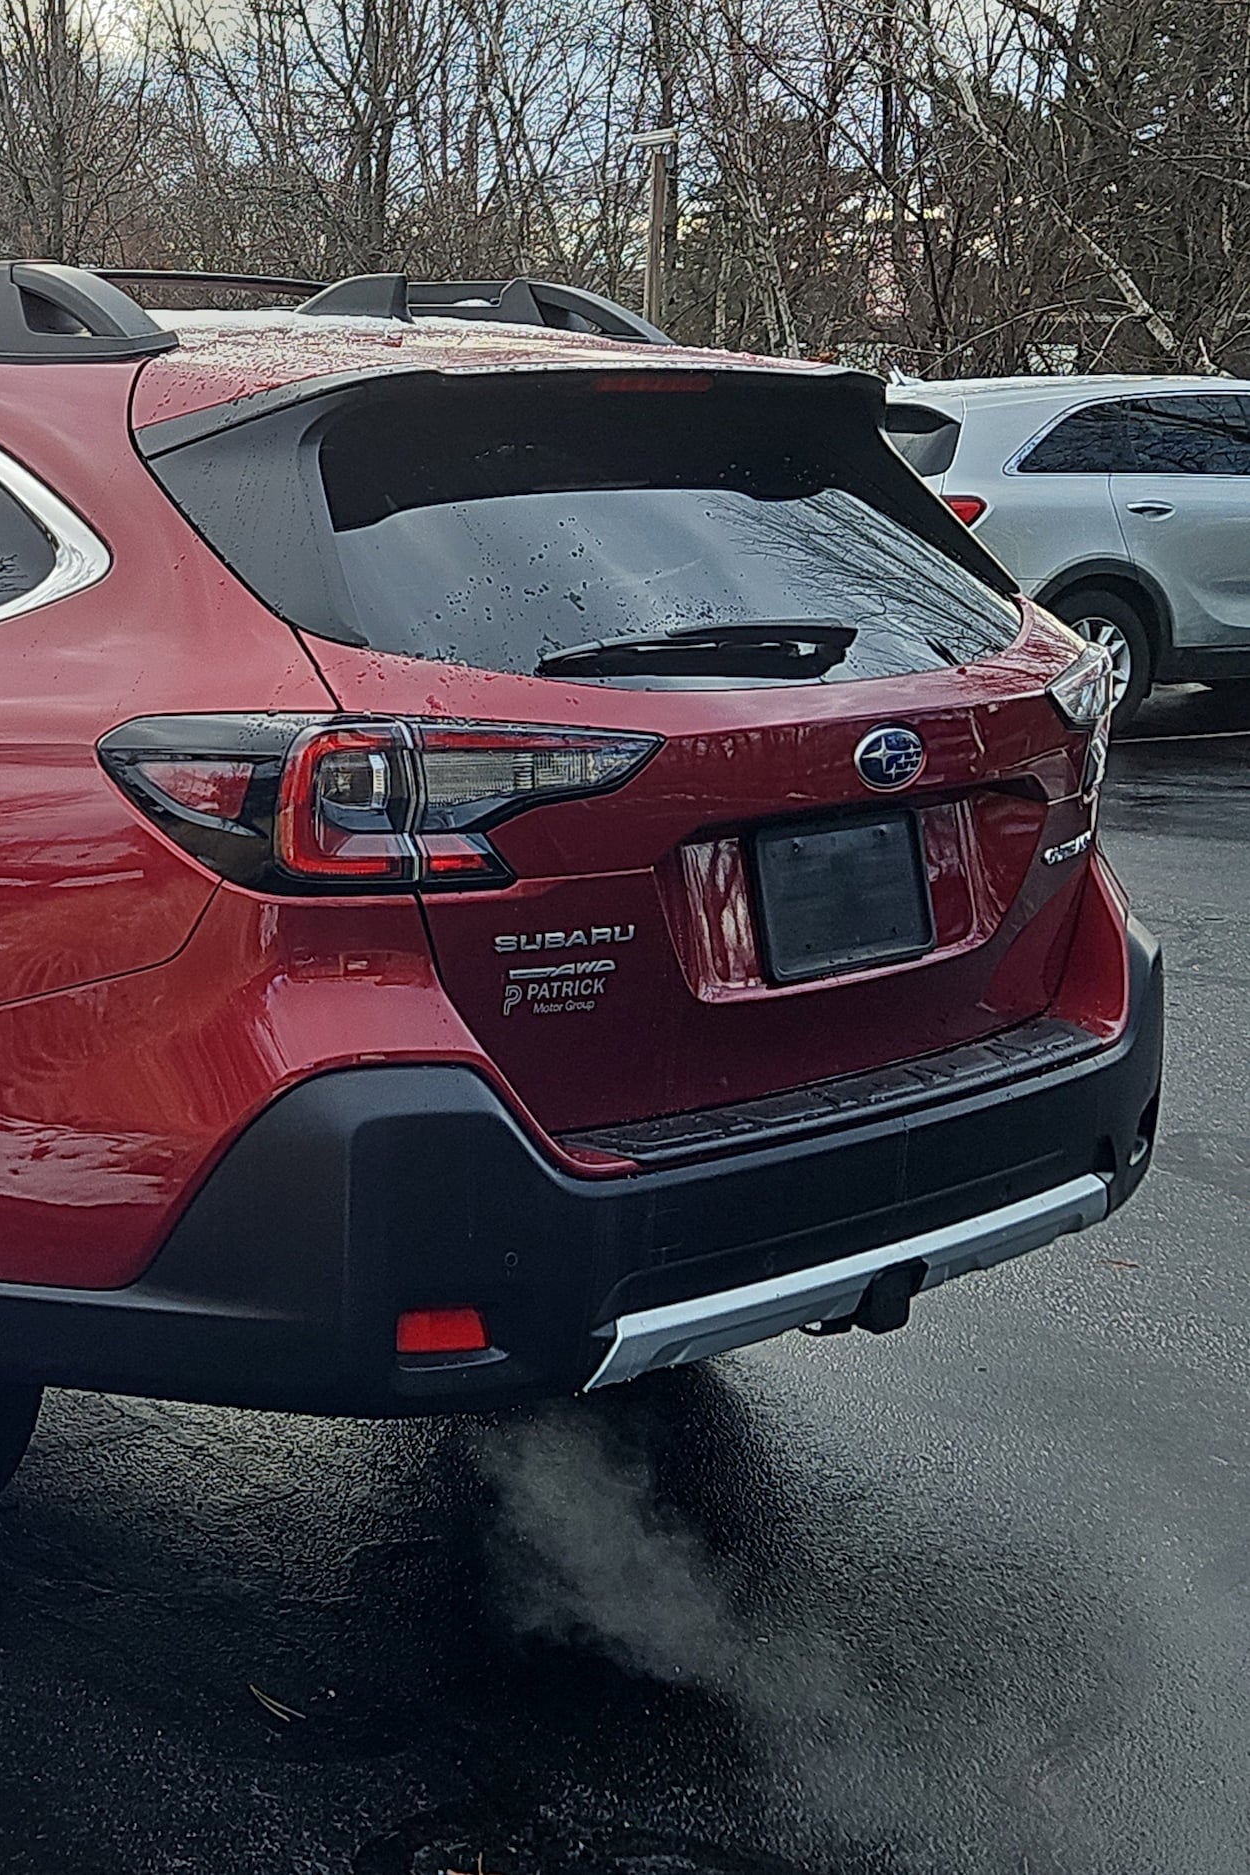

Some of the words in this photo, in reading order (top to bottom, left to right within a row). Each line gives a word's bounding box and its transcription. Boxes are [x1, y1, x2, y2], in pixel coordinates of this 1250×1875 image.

[494, 924, 635, 952] SUBARU
[551, 959, 616, 977] AWD
[527, 977, 606, 1000] PATRICK
[533, 1002, 563, 1014] Motor
[565, 1000, 595, 1011] Group
